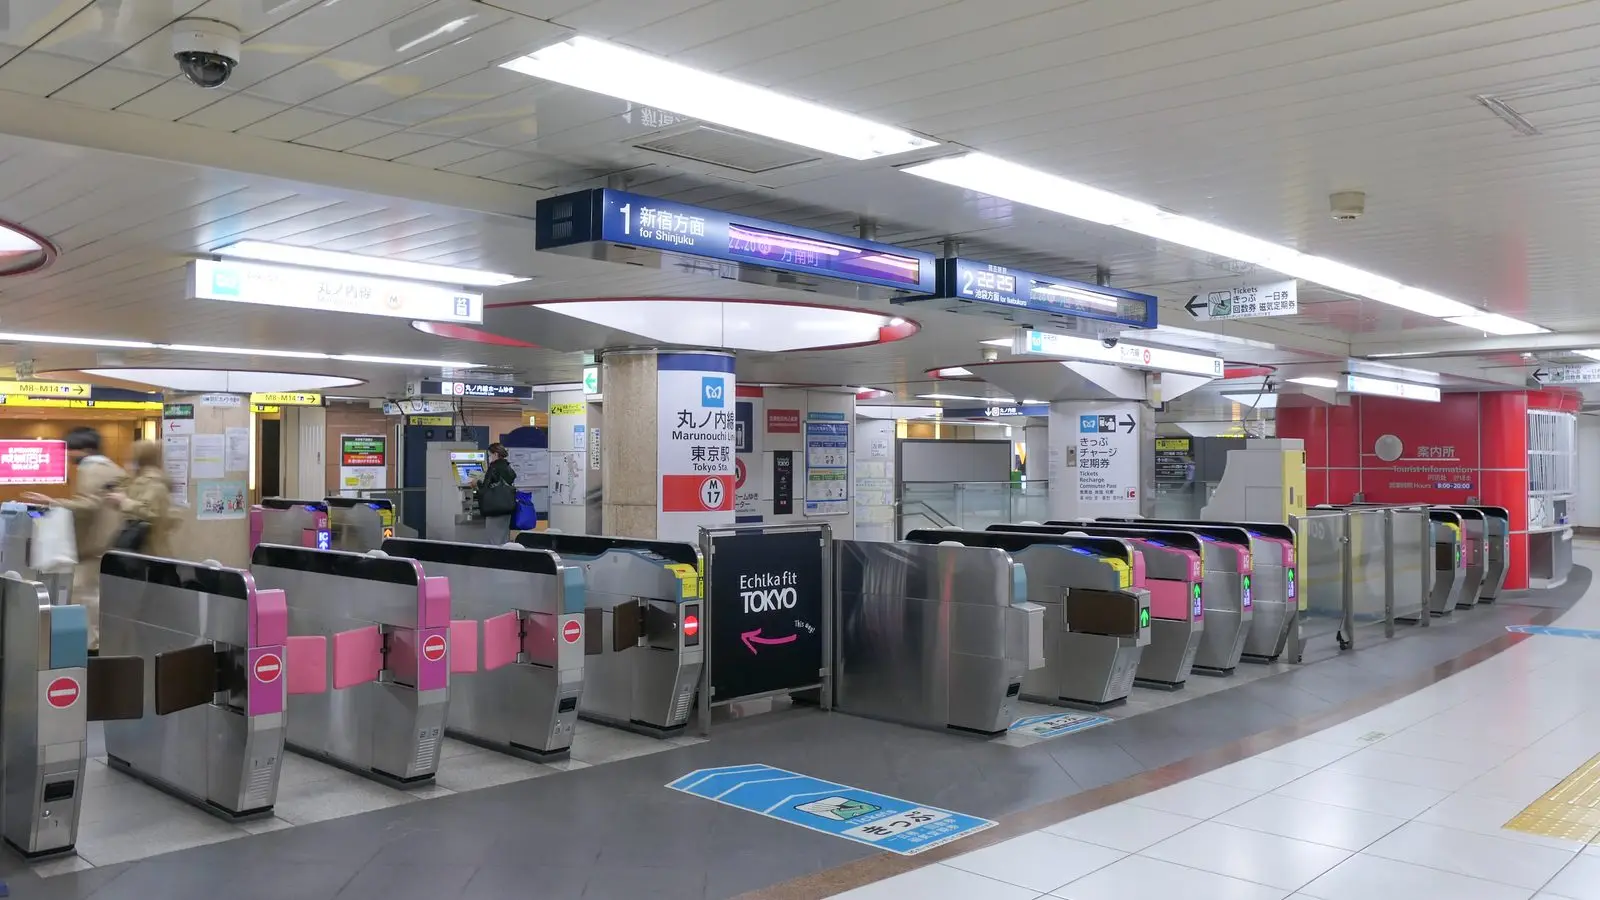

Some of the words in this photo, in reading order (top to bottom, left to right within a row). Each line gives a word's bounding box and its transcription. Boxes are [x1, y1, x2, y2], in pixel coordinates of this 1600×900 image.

[620, 203, 631, 235] 1
[639, 206, 705, 237] 新宿方面
[639, 227, 652, 239] for
[655, 231, 695, 246] Shinjuku
[962, 270, 974, 295] 2
[1233, 287, 1258, 295] Tickets
[1233, 294, 1256, 304] きっぷ
[1265, 291, 1289, 300] 一日券
[1233, 303, 1256, 313] 回数券
[677, 409, 734, 430] 丸ノ内線
[672, 431, 727, 441] Marunouchi
[1080, 437, 1109, 447] きっぷ
[691, 445, 730, 462] 東京駅
[1080, 447, 1118, 457] チャージ
[1417, 446, 1455, 457] 案内所
[693, 463, 716, 472] Tokyo
[1080, 458, 1110, 469] 定期券
[1393, 465, 1420, 473] Tourist
[1421, 465, 1473, 473] Information
[709, 480, 718, 489] M
[707, 491, 721, 504] 17
[319, 531, 329, 541] IC
[740, 573, 781, 589] Echika
[782, 571, 798, 585] fit
[740, 587, 798, 614] TOKYO
[845, 809, 898, 825] Tickets
[862, 810, 935, 836] きっぷ
